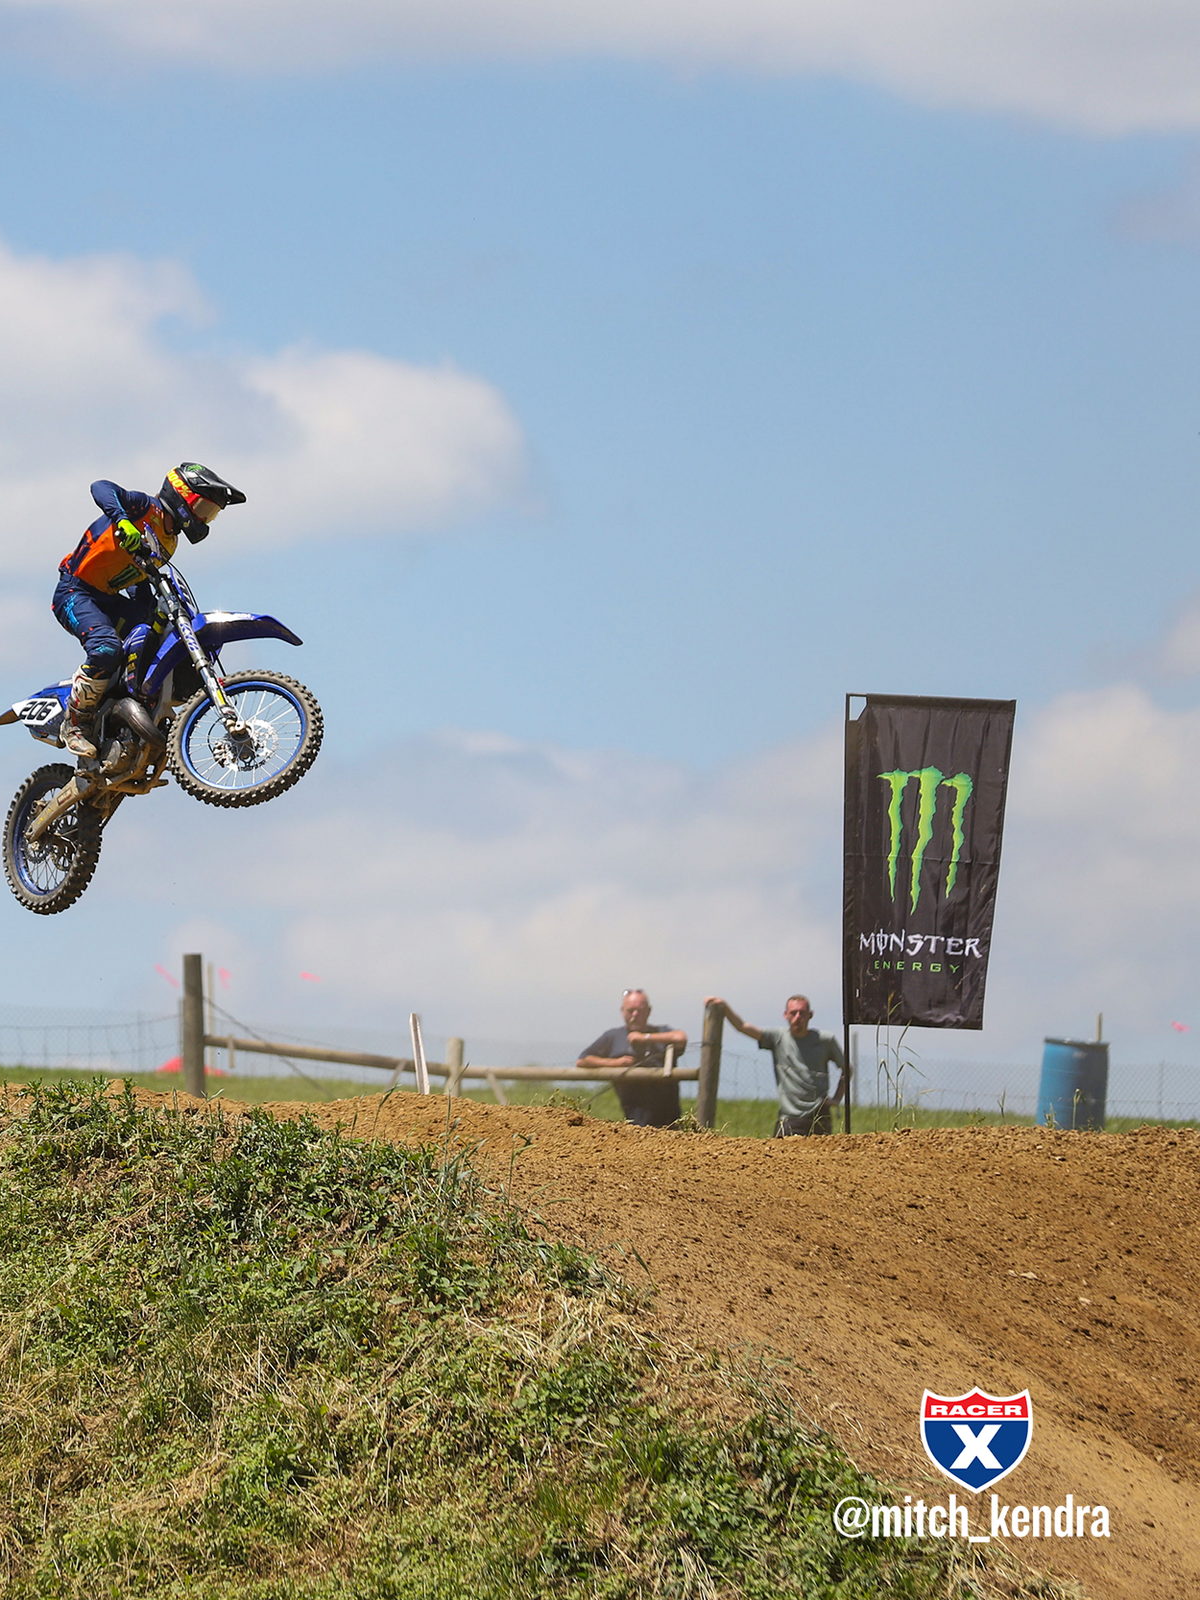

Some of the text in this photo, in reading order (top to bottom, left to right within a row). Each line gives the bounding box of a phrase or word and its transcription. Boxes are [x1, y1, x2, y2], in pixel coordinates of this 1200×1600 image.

[19, 701, 57, 721] 206
[859, 928, 983, 959] MONSTER
[874, 960, 960, 974] ENERGY
